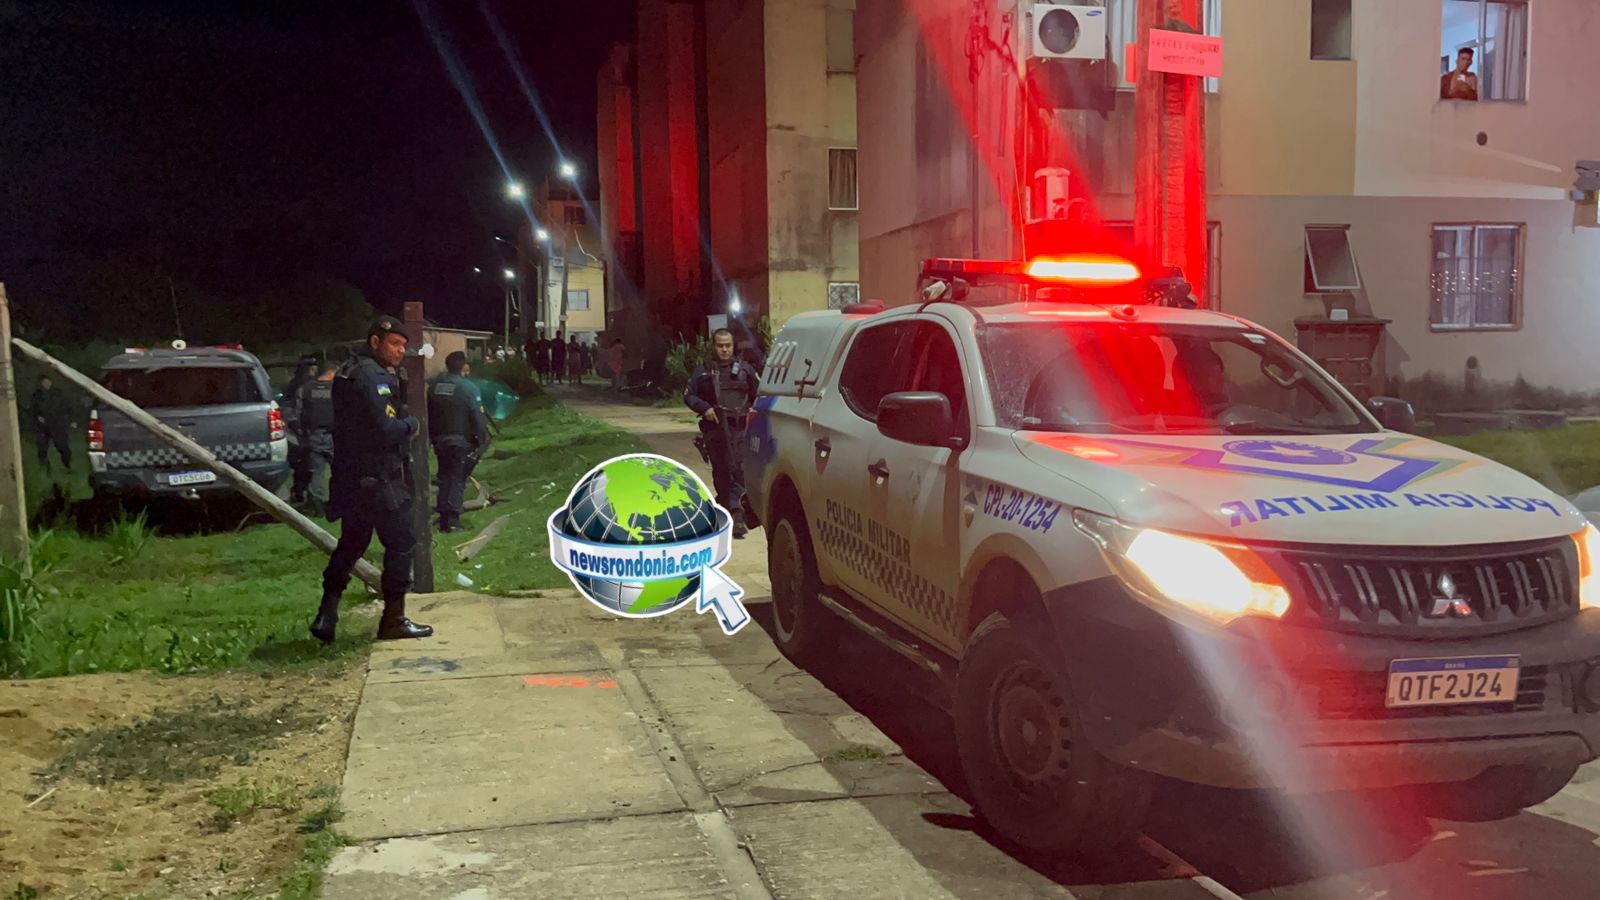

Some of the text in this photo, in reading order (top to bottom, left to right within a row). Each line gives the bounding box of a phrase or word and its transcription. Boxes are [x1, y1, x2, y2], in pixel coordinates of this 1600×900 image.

[983, 484, 1062, 534] CPL-20-1254
[867, 518, 911, 569] MILITAR
[1399, 671, 1502, 701] QTF2J24
